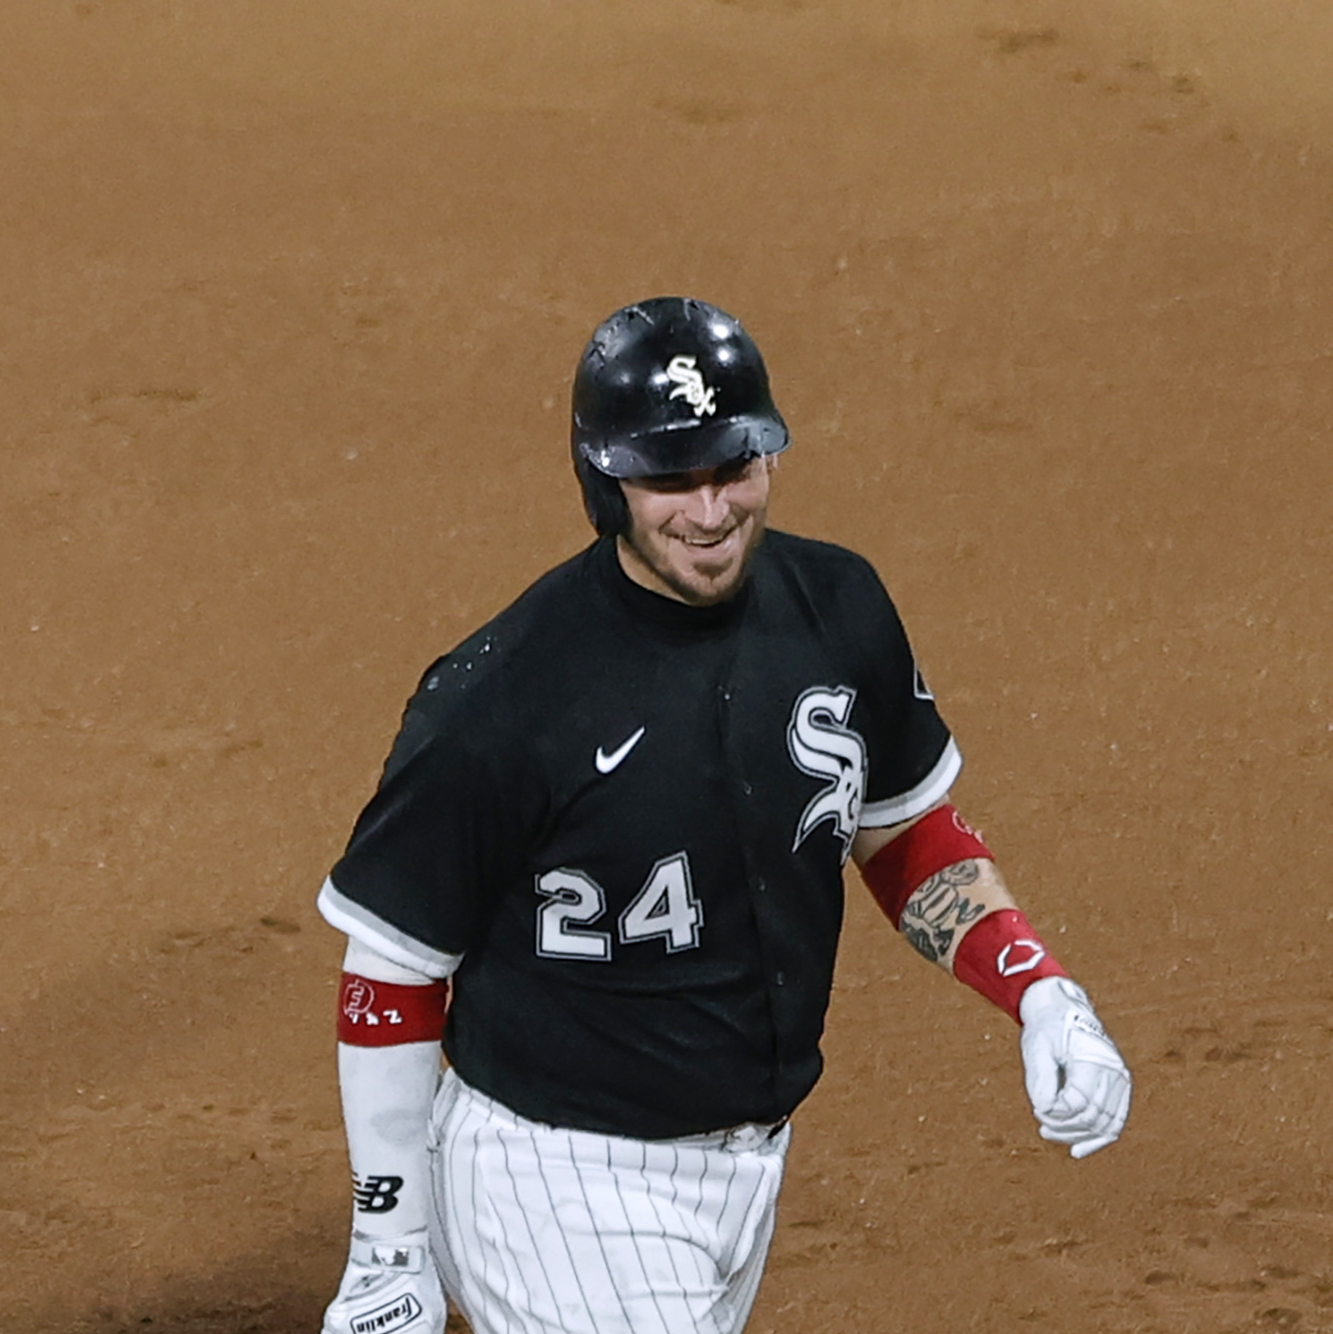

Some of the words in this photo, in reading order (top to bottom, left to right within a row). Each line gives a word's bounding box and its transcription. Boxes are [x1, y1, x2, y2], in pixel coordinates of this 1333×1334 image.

[666, 354, 717, 417] Sox
[787, 684, 868, 866] So
[535, 850, 704, 962] 24
[356, 1296, 412, 1334] franklin
